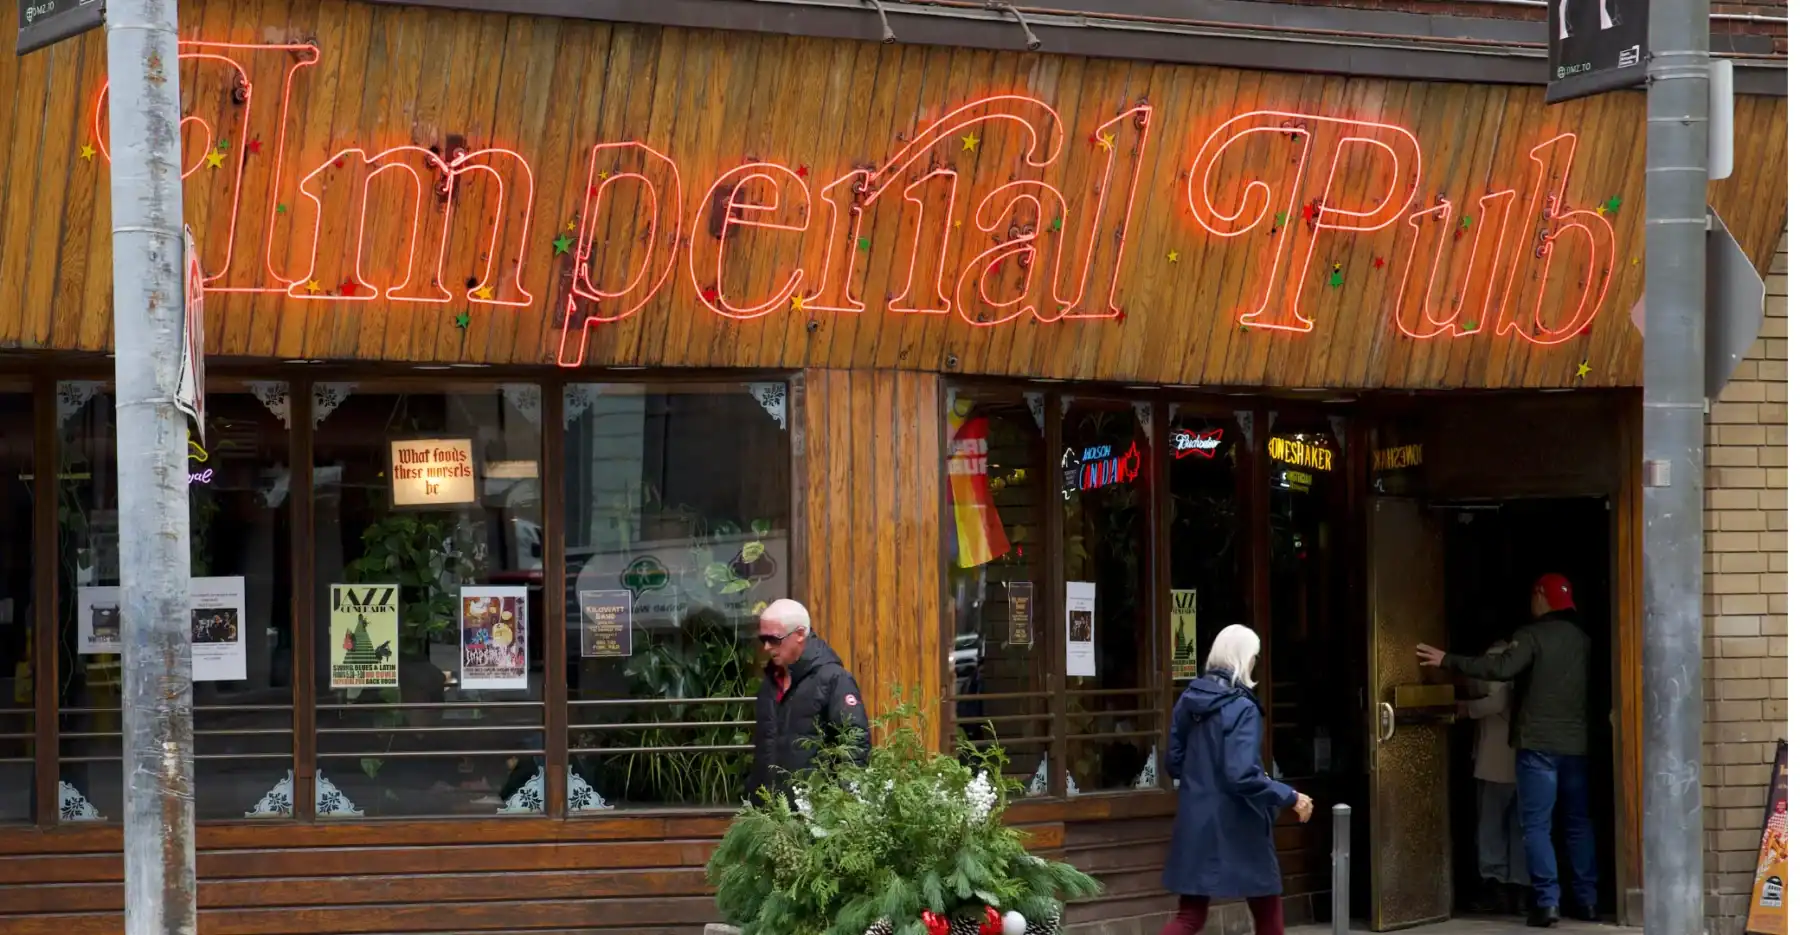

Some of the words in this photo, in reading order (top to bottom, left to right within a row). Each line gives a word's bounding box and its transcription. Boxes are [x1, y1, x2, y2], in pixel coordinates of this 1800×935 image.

[95, 41, 1152, 367] Imperial
[1188, 110, 1615, 345] Pub
[398, 448, 430, 464] What
[433, 447, 467, 462] foods
[1082, 446, 1111, 461] MOLSON
[188, 468, 213, 484] yal
[395, 465, 424, 479] these
[427, 463, 471, 478] morsels
[1080, 456, 1127, 491] CANADIAN
[425, 480, 440, 495] be
[333, 588, 395, 612] JAZZ
